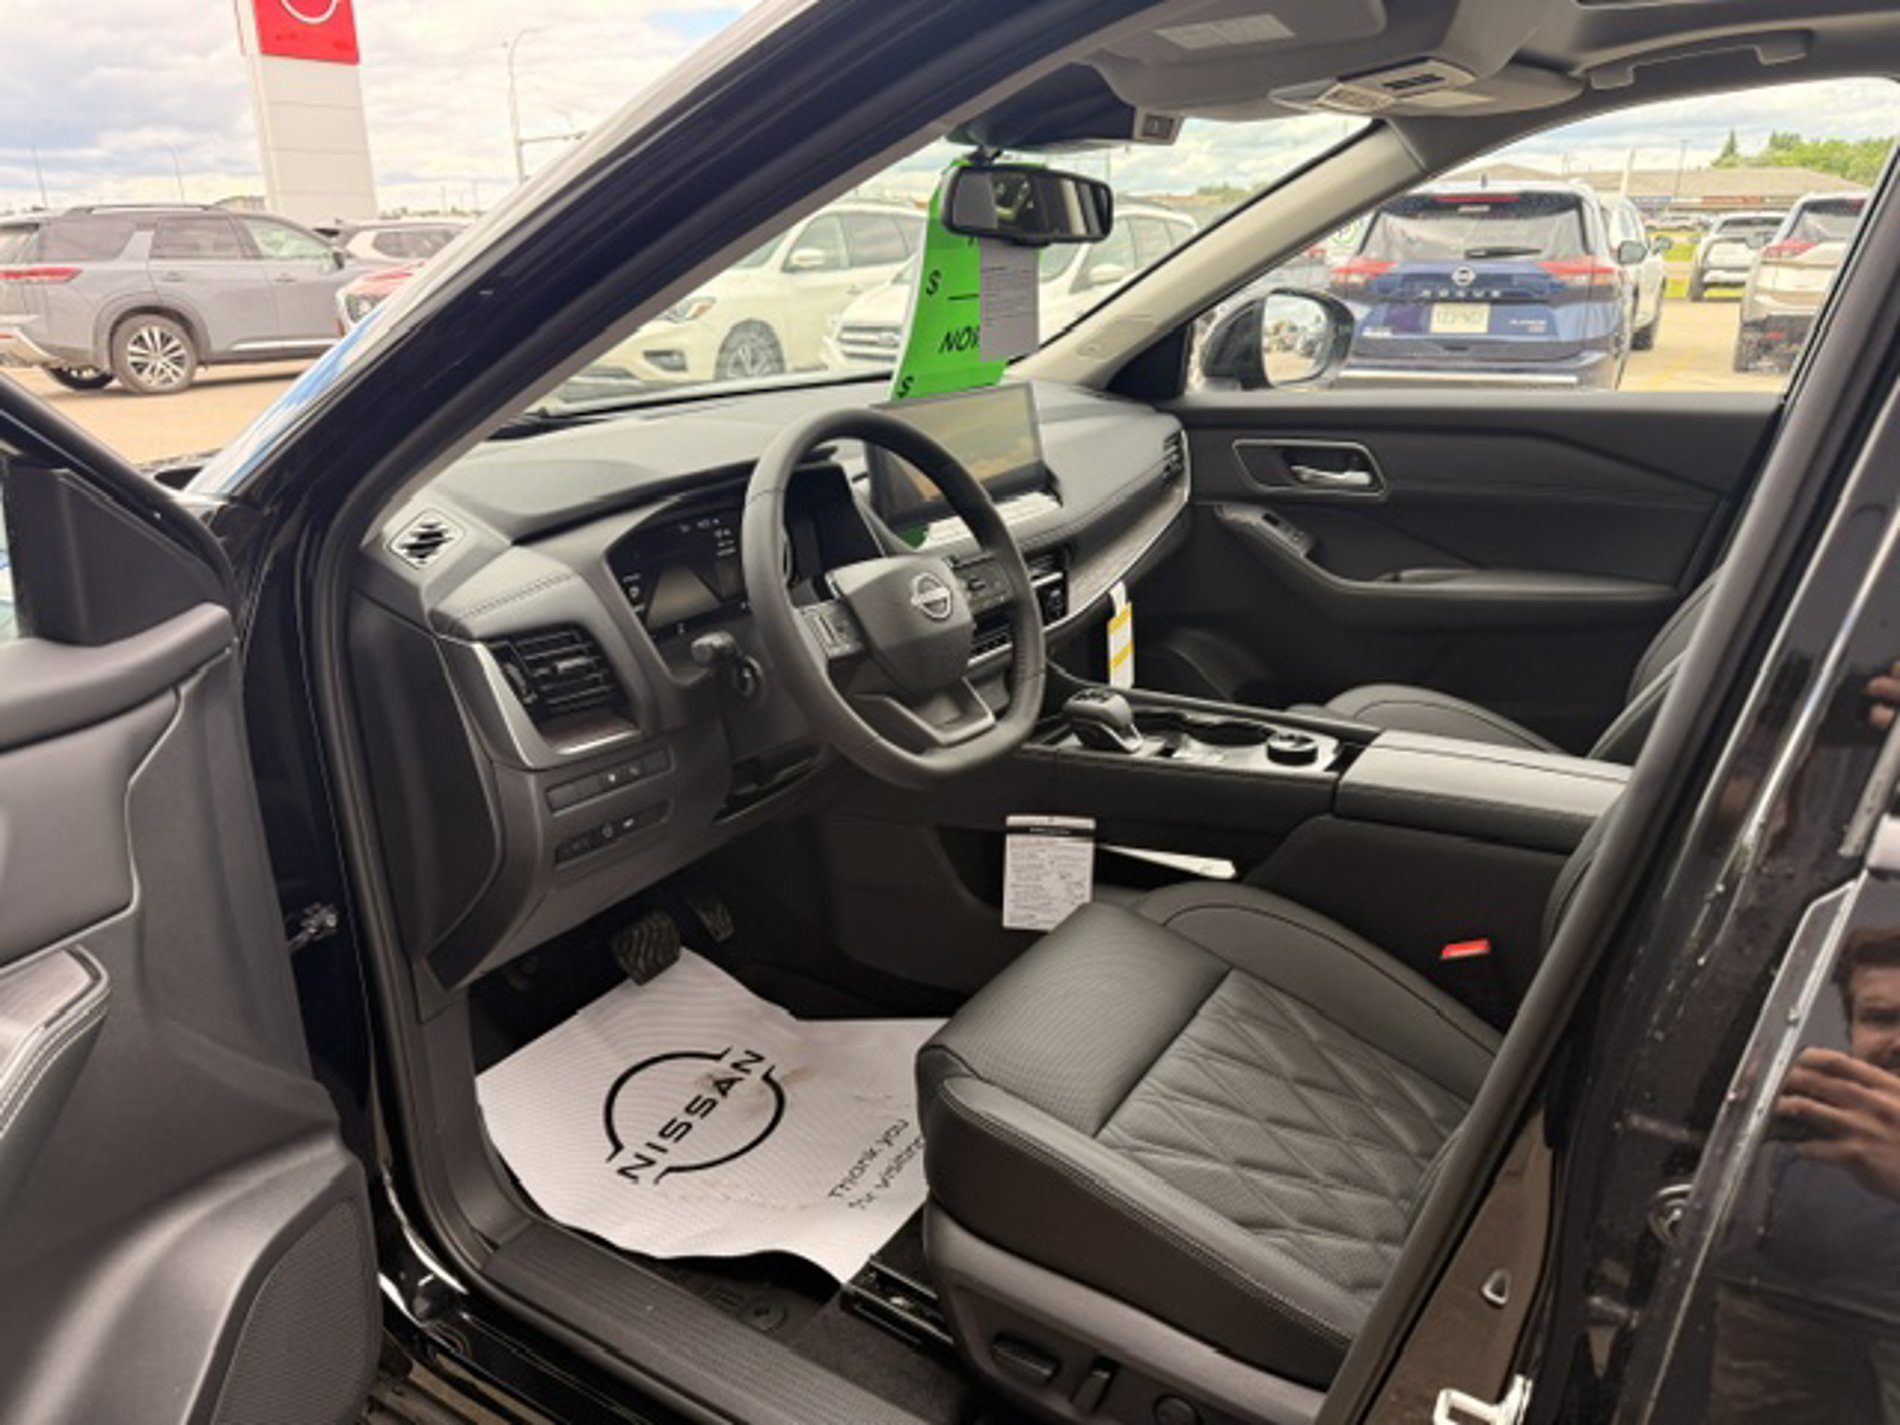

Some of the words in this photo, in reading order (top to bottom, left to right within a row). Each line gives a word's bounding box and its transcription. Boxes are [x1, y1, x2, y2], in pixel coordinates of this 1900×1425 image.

[615, 1049, 766, 1184] NISSAN
[827, 1146, 883, 1197] Thank
[874, 1118, 909, 1148] you
